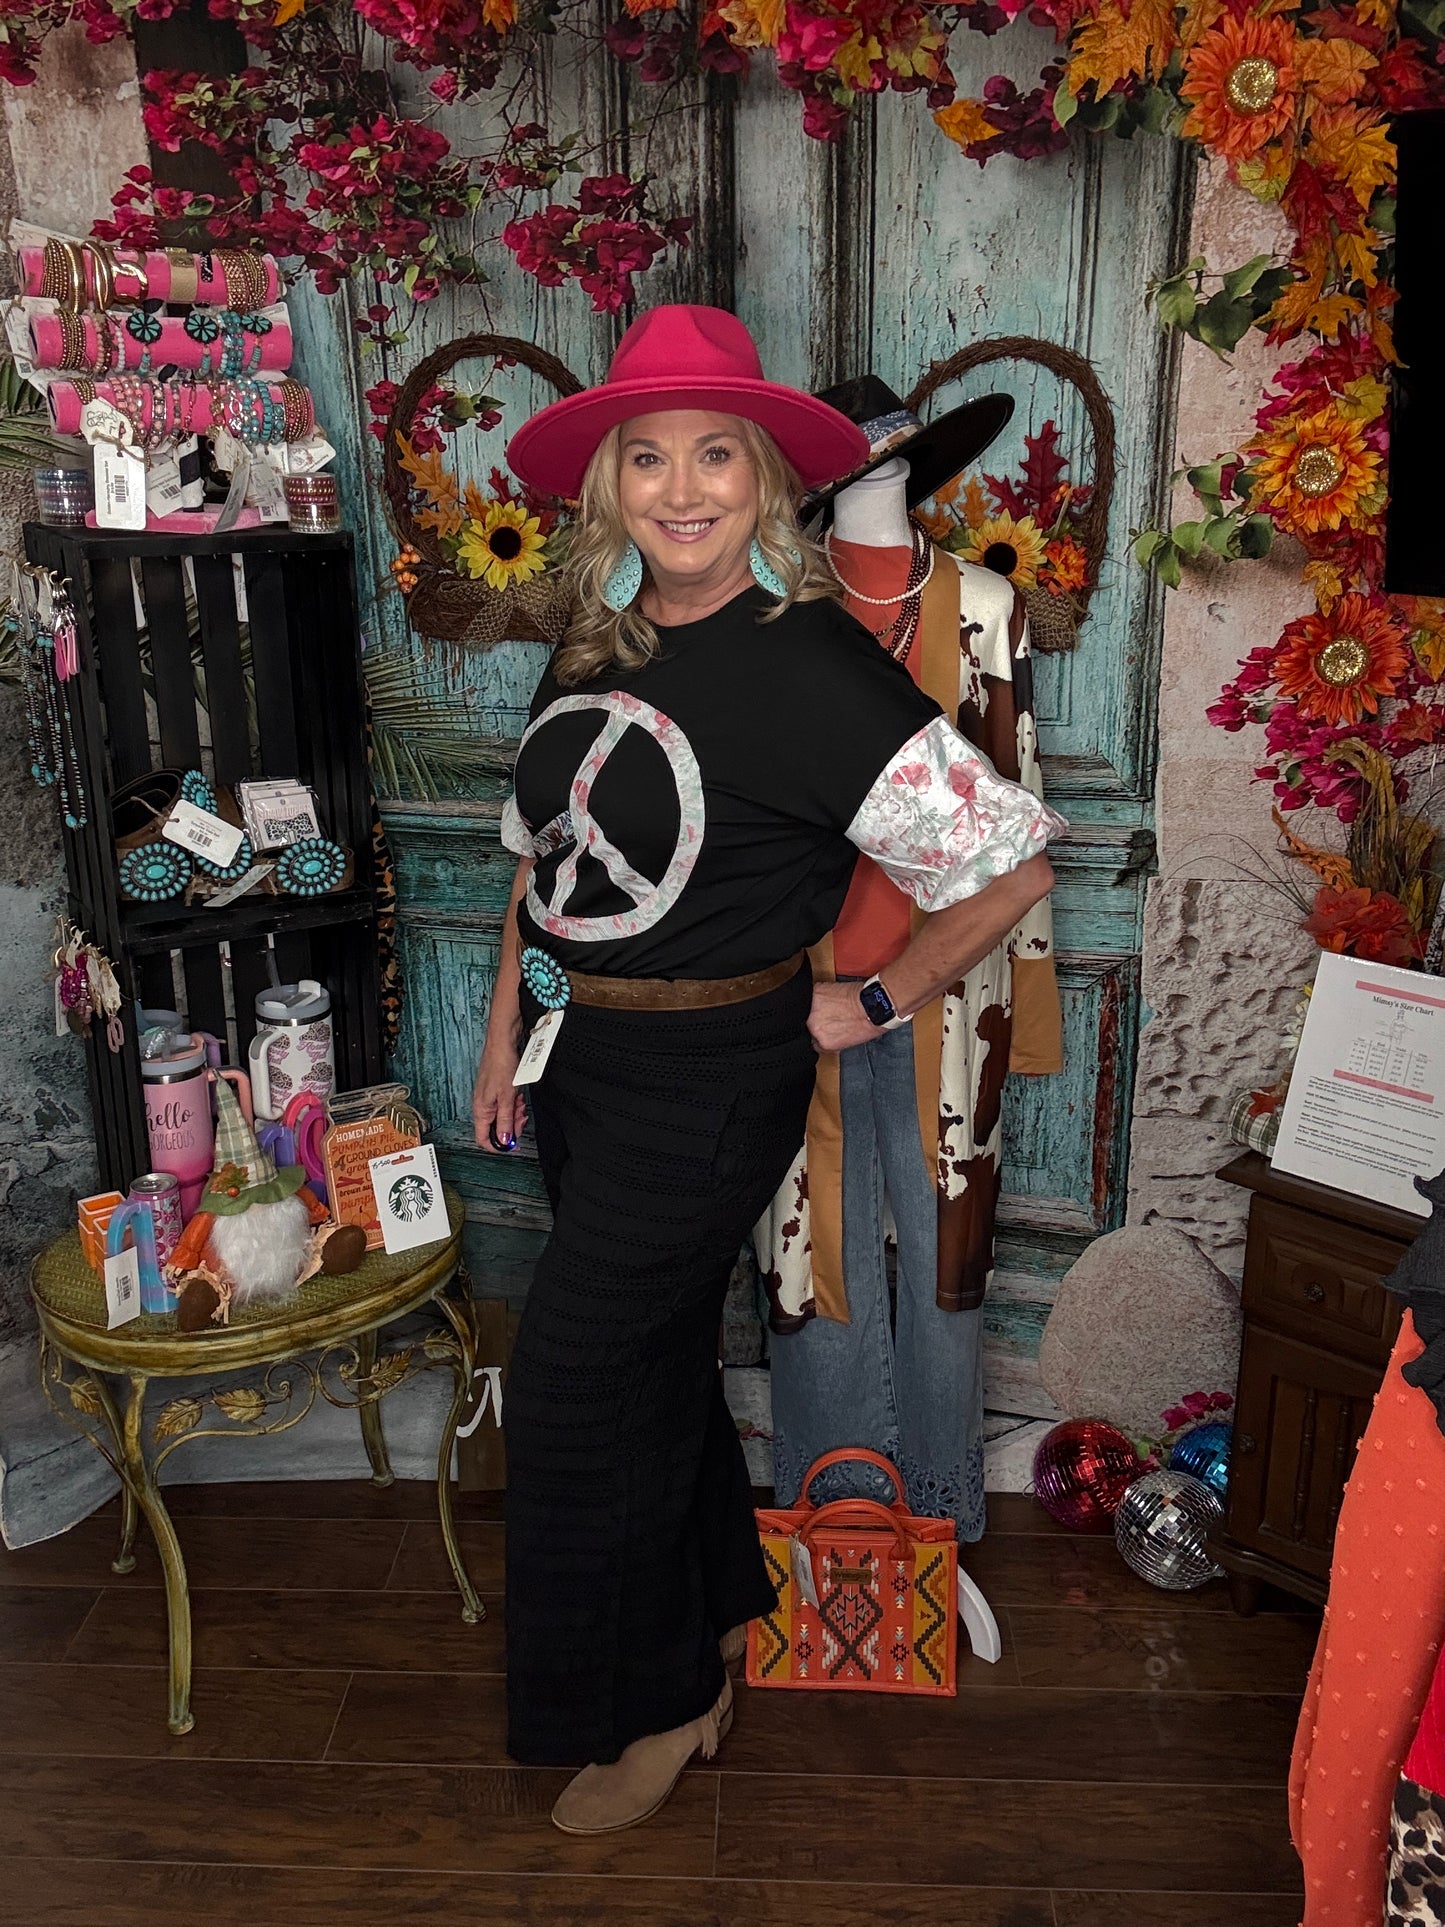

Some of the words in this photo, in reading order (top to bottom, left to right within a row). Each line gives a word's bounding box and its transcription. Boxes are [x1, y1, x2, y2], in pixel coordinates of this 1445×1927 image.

[1400, 1002, 1415, 1012] Size
[1414, 1006, 1435, 1016] Chart
[145, 1101, 194, 1132] hello
[150, 1129, 195, 1151] ORGEOUS
[336, 1123, 384, 1143] HOMEMADE
[346, 1147, 381, 1164] GROUND
[384, 1139, 414, 1155] CLOVES
[340, 1187, 362, 1198] brown
